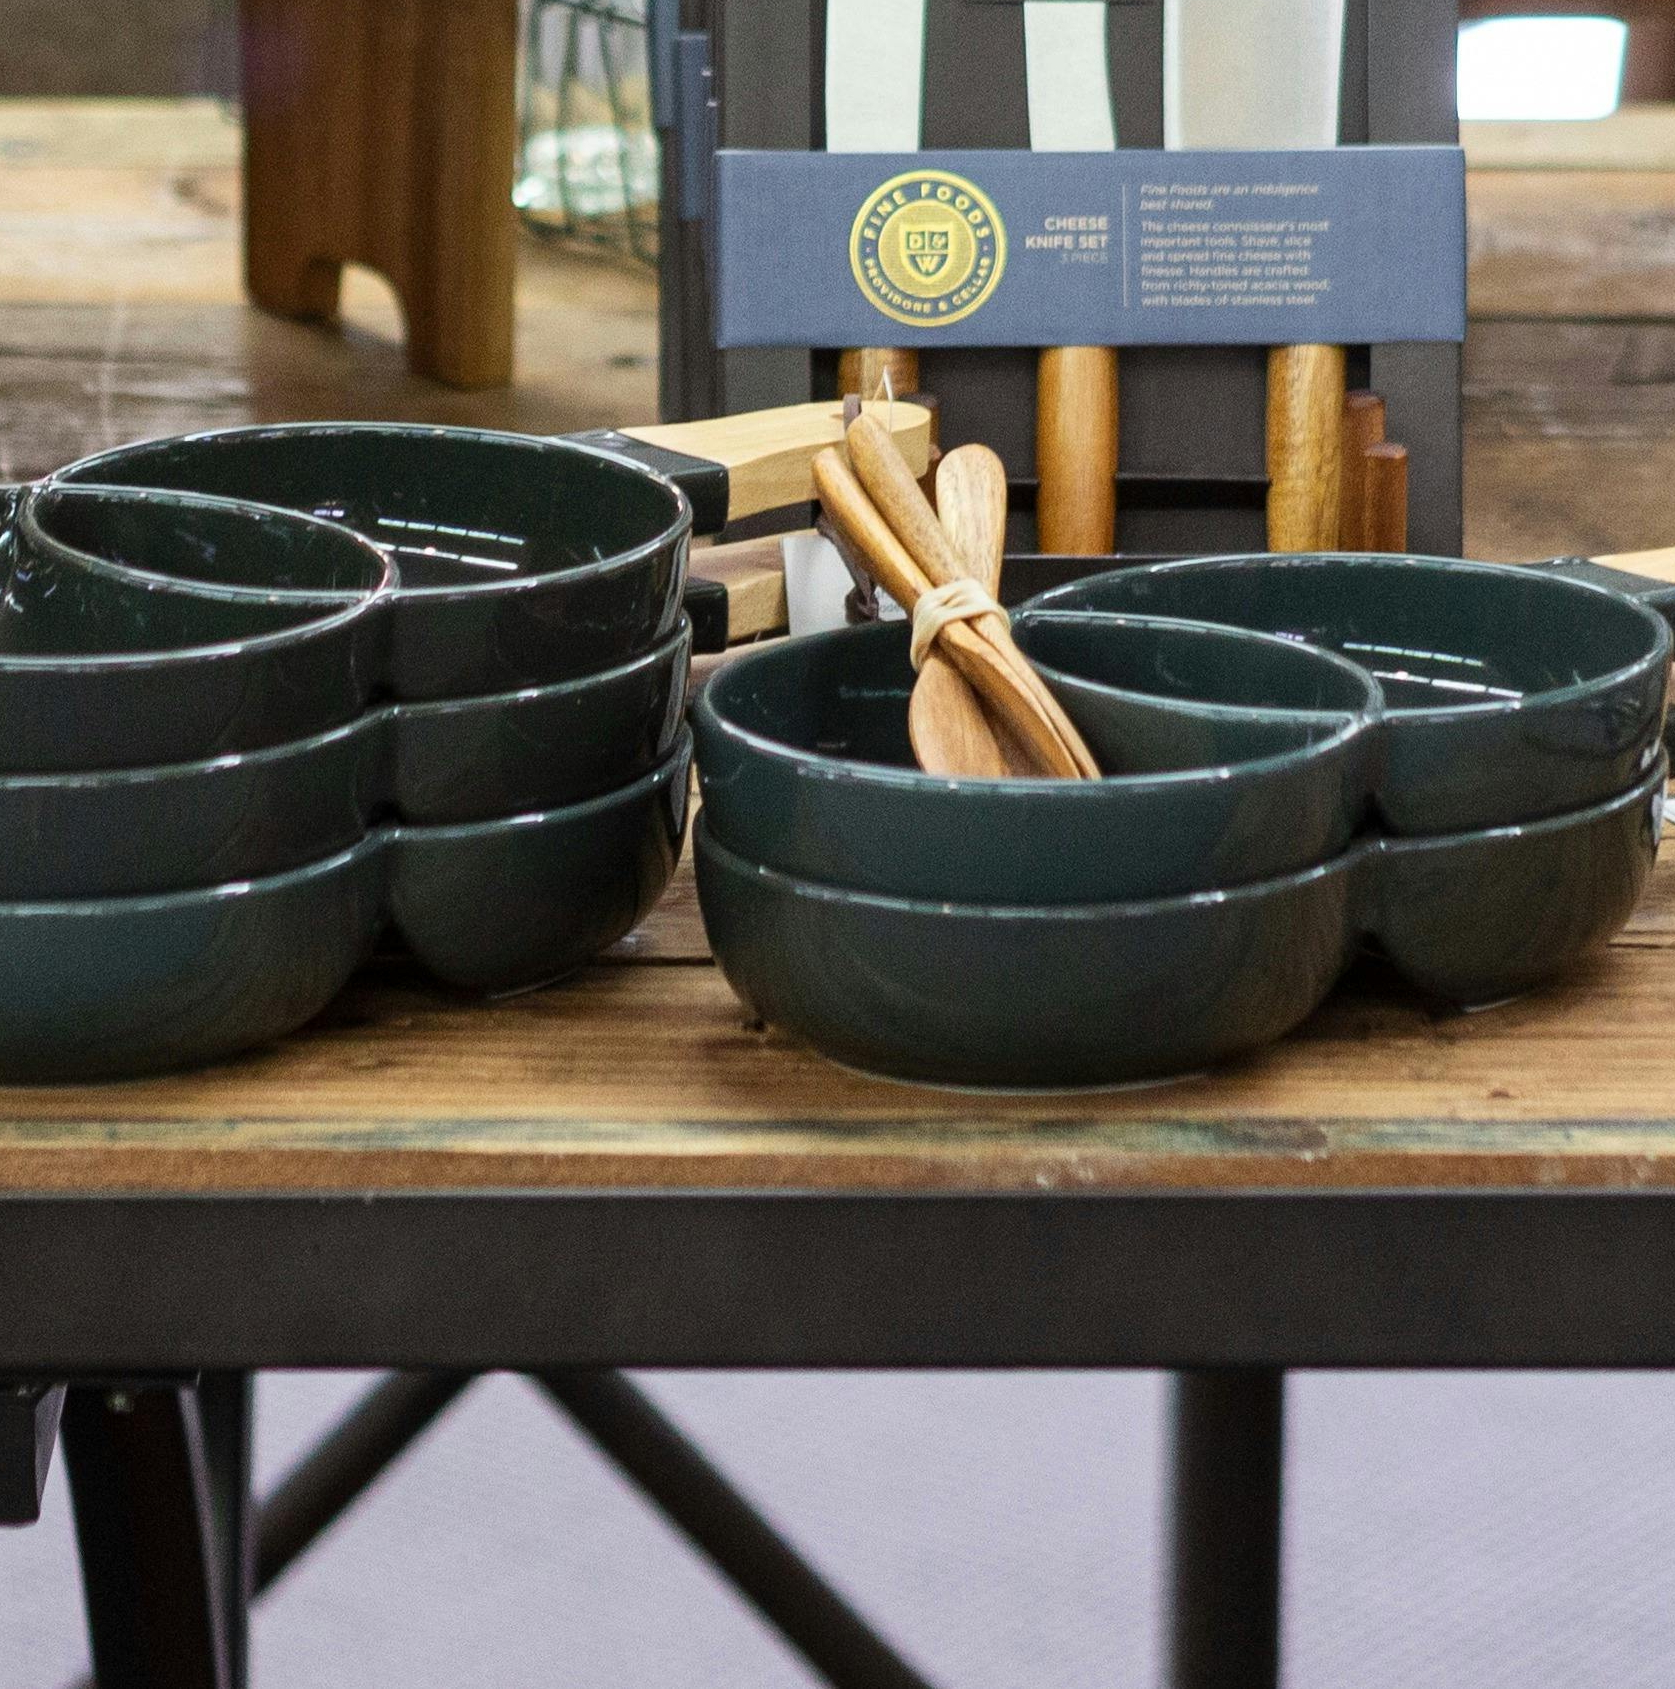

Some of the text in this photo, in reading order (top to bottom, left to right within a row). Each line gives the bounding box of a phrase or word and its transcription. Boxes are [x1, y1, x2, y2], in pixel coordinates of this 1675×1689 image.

[1141, 185, 1167, 195] Fine
[1170, 185, 1208, 195] Foods
[1140, 199, 1167, 211] best
[863, 182, 991, 241] FINE FOODS
[1044, 216, 1109, 232] CHEESE
[1141, 221, 1163, 232] The
[1167, 221, 1210, 232] cheese
[1298, 221, 1330, 232] most
[1026, 234, 1109, 249] KNIFE SET
[1141, 236, 1201, 249] important
[1141, 251, 1164, 262] and
[1238, 251, 1282, 262] cheese
[1285, 251, 1312, 262] with
[864, 257, 932, 314] PROVIDORE
[952, 255, 991, 307] CELLAR
[1141, 280, 1171, 291] from
[1141, 295, 1168, 306] with
[1171, 295, 1212, 306] blades
[1214, 294, 1228, 306] of
